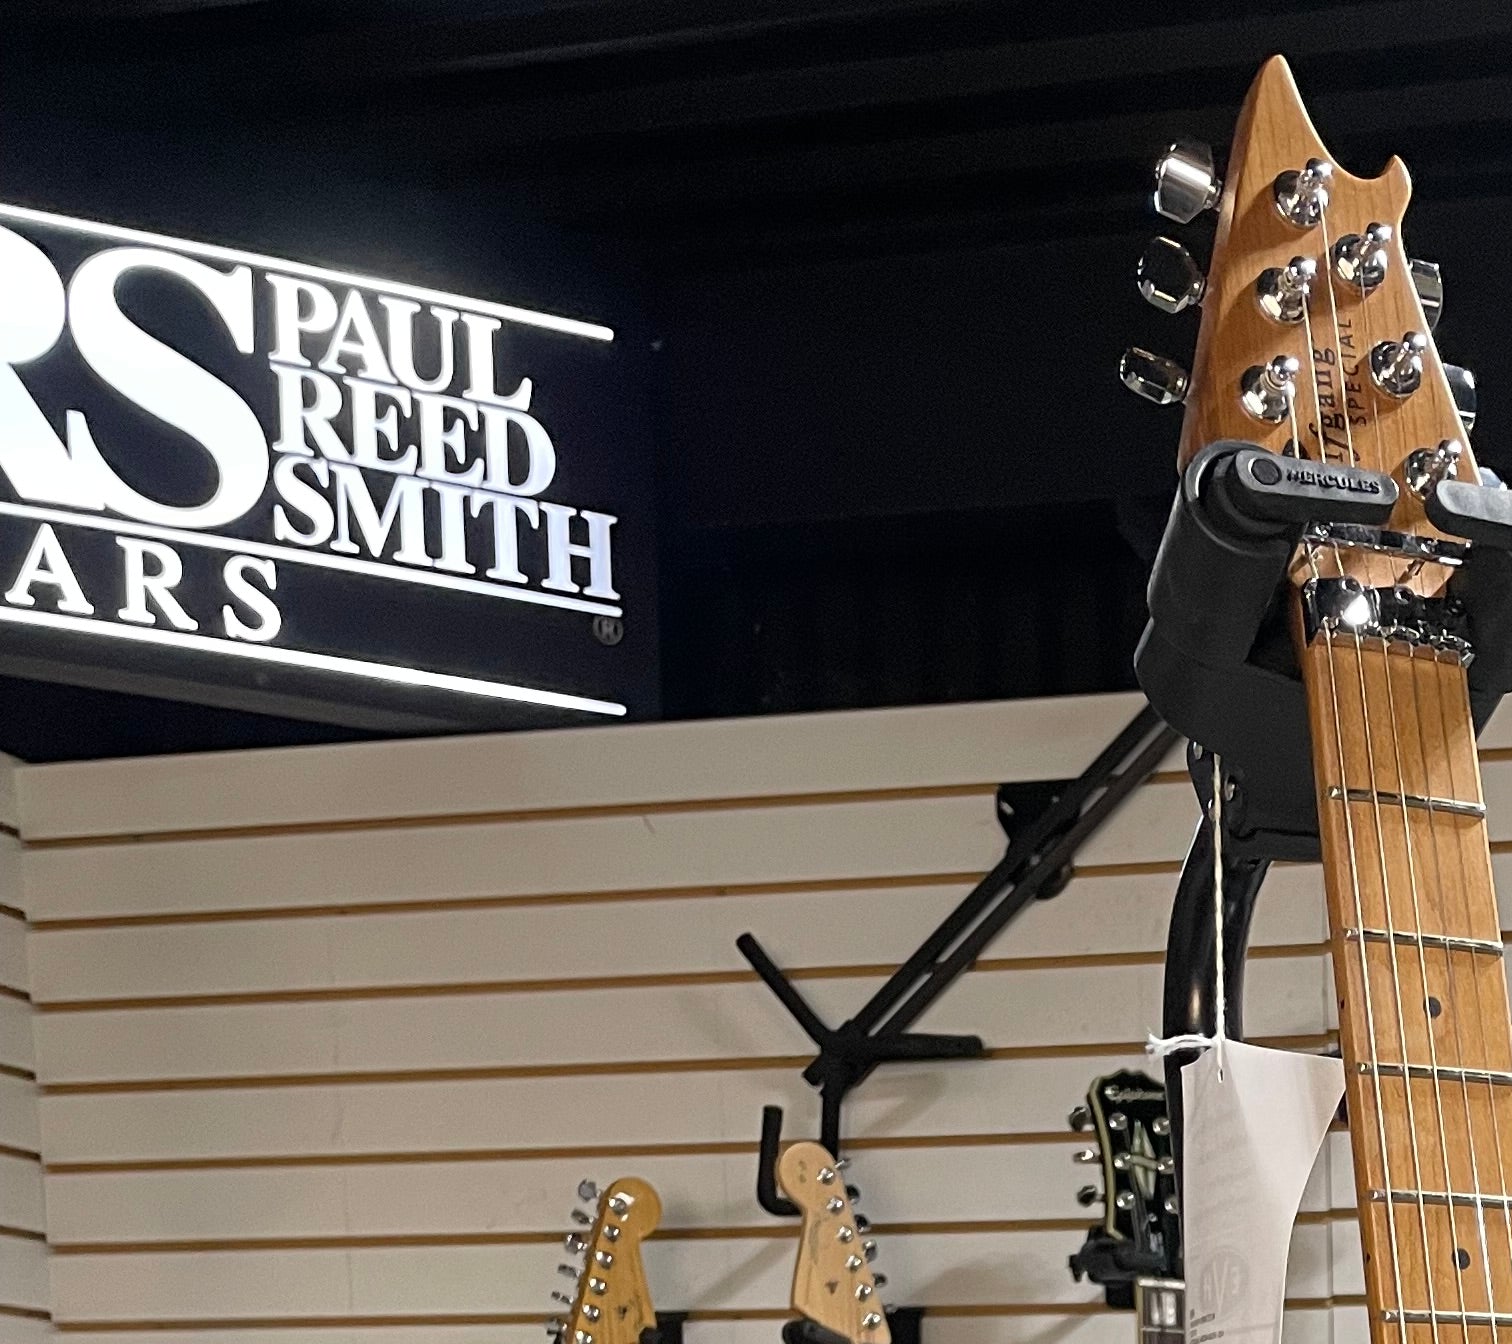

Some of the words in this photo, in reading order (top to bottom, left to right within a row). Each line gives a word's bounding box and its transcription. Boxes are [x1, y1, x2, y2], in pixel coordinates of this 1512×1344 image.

[265, 272, 532, 411] PAUL
[1339, 319, 1368, 427] SPECIAL
[271, 360, 557, 497] REED
[1287, 469, 1381, 495] HERCULES
[272, 452, 622, 601] SMITH
